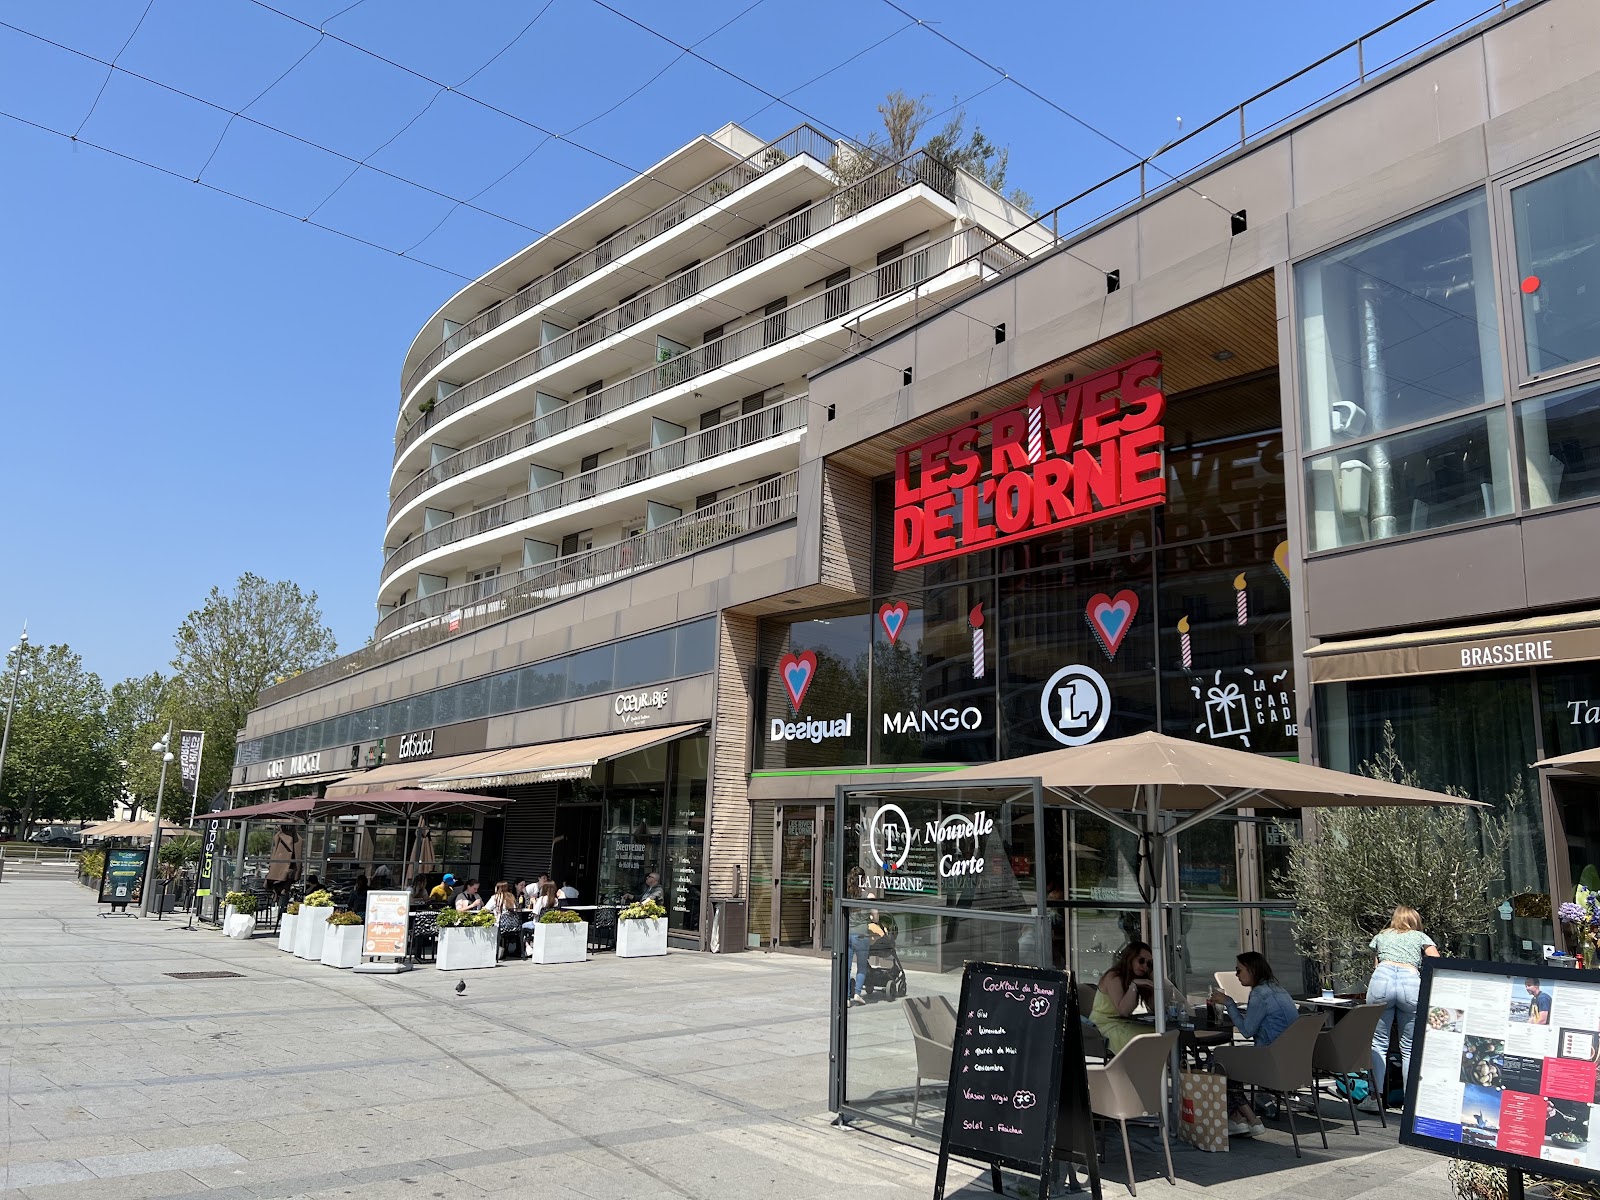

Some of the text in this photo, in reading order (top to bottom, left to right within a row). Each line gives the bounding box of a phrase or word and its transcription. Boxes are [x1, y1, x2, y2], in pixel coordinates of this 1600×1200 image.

[895, 359, 1166, 507] LES RIVES
[893, 492, 956, 564] DE
[962, 425, 1166, 546] L'ORNE
[1460, 640, 1553, 667] BRASSERIE
[1253, 679, 1266, 692] LA
[1254, 689, 1297, 710] CAR
[770, 713, 852, 744] Desigual
[883, 706, 983, 735] MANGO
[399, 730, 434, 759] EatSalad
[924, 810, 994, 844] Nouvelle
[616, 840, 645, 851] Bienvenue
[939, 854, 985, 878] Carte
[858, 875, 872, 889] LA
[873, 875, 924, 892] TAVERNE
